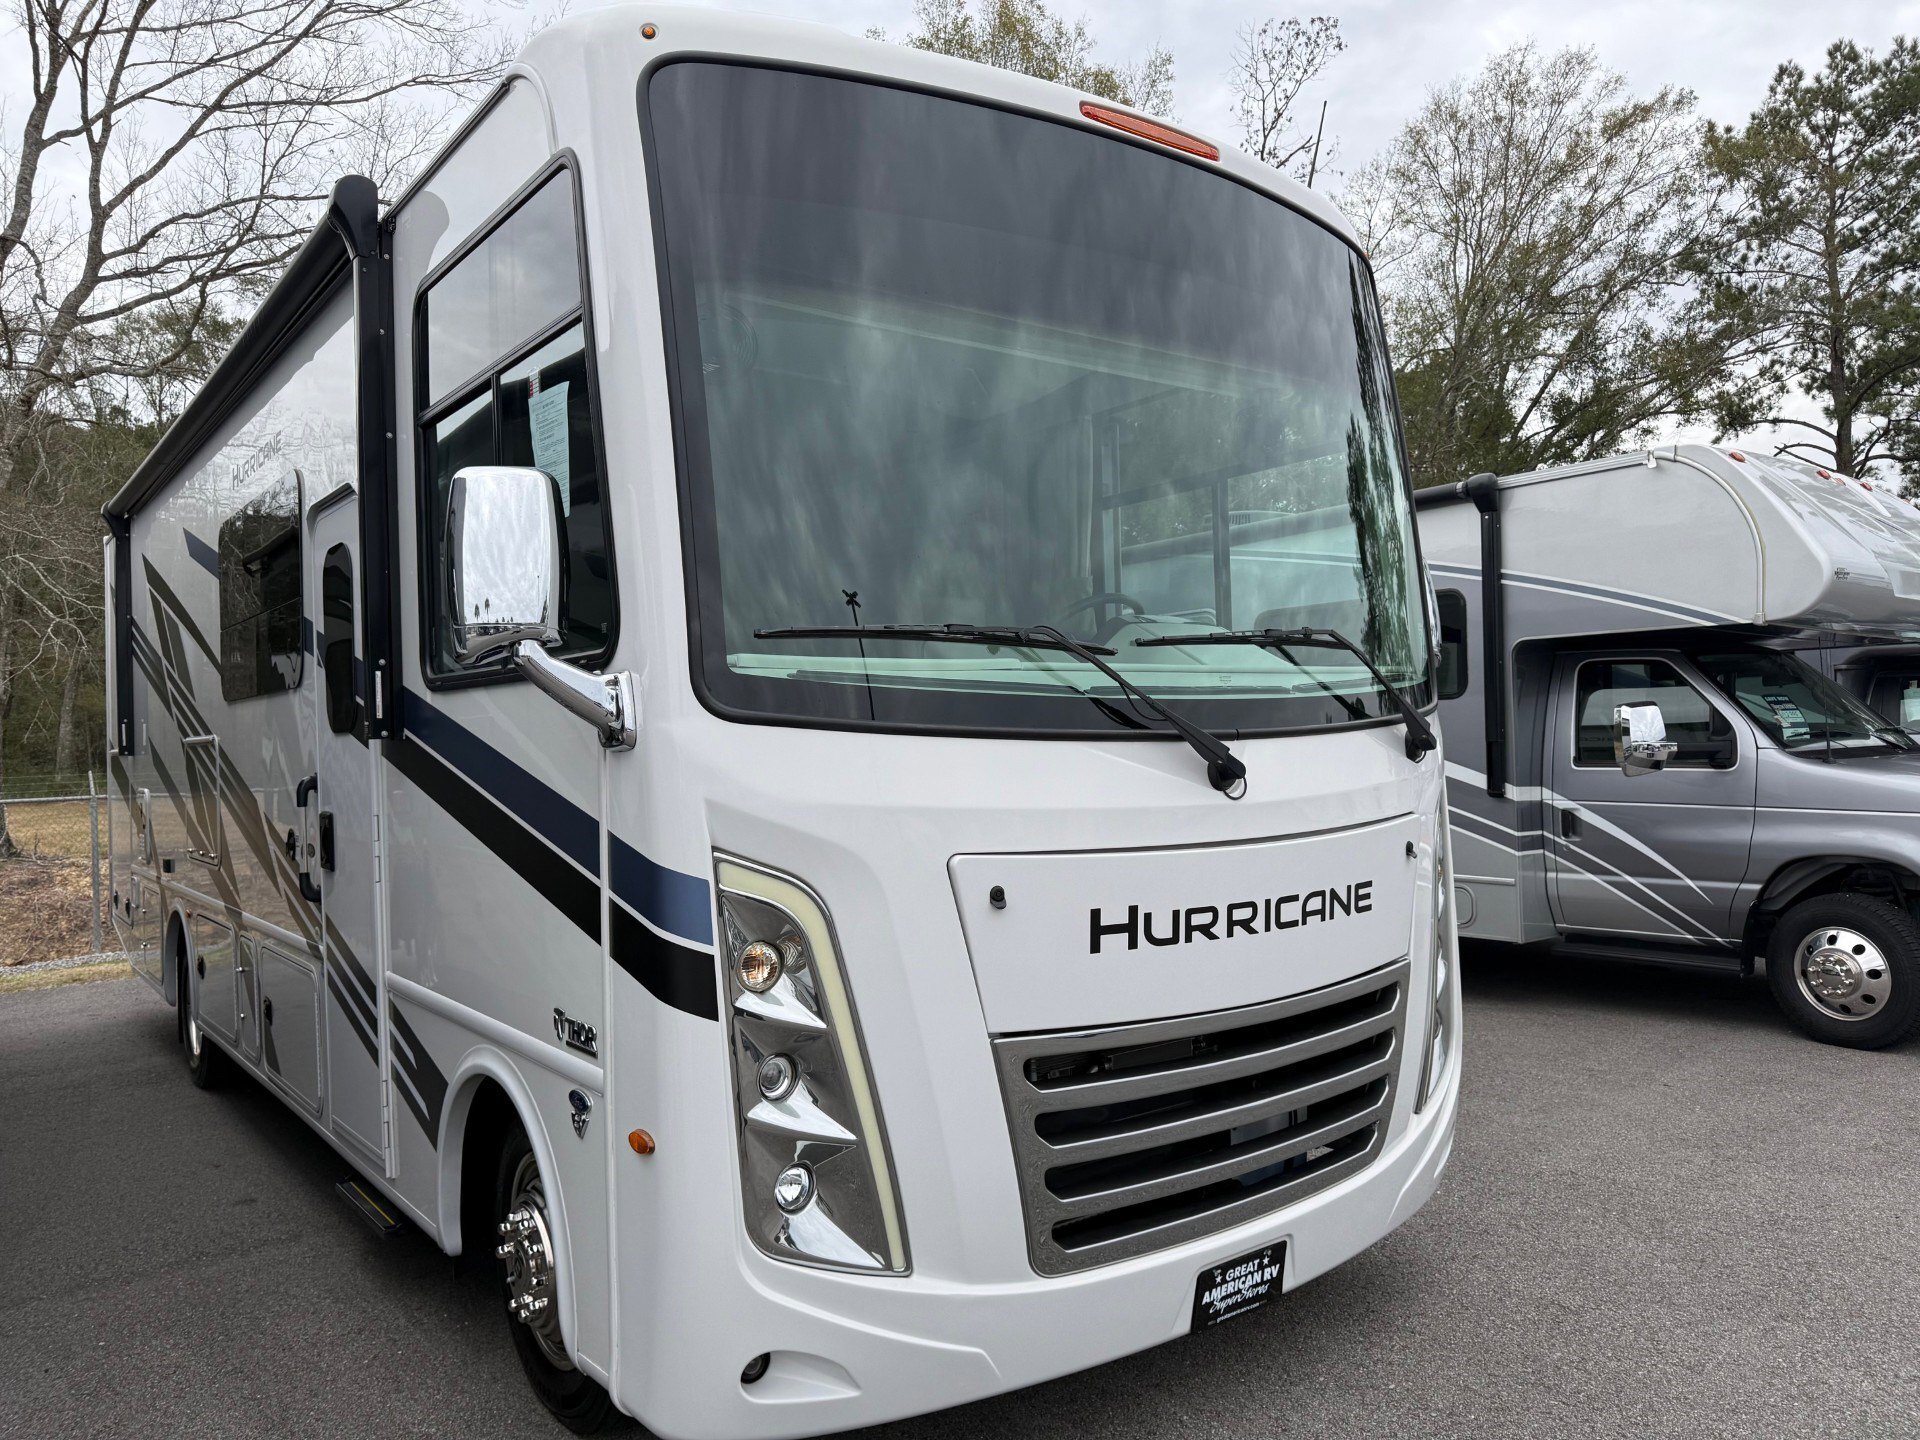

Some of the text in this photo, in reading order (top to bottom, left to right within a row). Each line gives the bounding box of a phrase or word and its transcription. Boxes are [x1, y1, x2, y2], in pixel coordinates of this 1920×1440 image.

[231, 429, 282, 491] HURRICANE
[1089, 879, 1373, 955] HURRICANE
[564, 1016, 598, 1052] THOR
[1201, 1263, 1280, 1306] AMERICAN RV
[1225, 1258, 1260, 1281] GREAT
